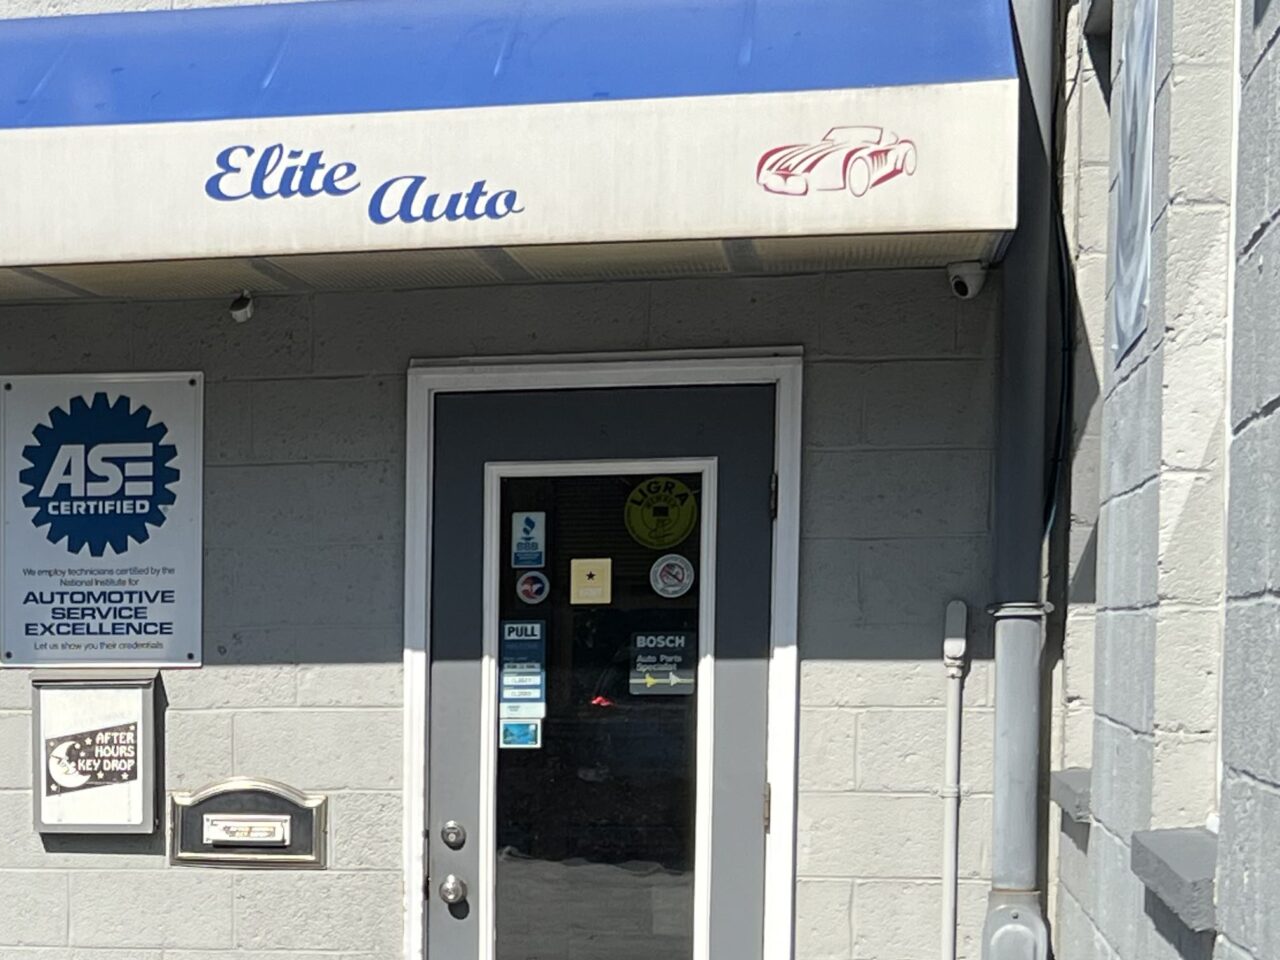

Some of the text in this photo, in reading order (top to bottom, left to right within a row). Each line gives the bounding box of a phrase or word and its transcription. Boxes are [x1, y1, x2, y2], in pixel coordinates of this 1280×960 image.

[205, 143, 525, 225] Elite Auto
[38, 442, 154, 498] ASE
[47, 500, 151, 515] CERTIFIED
[23, 566, 175, 578] We employ technicians certified by the
[60, 577, 139, 587] National Institute for
[23, 590, 175, 604] AUTOMOTIVE
[51, 606, 148, 619] SERVICE
[24, 622, 173, 636] EXCELLENCE
[507, 626, 538, 637] PULL
[34, 642, 48, 650] Let
[60, 642, 82, 650] show
[83, 643, 99, 651] you
[100, 641, 117, 650] their
[118, 641, 164, 650] credentials
[636, 635, 686, 648] BOSCH
[95, 732, 135, 744] AFTER
[94, 745, 135, 758] HOURS
[77, 758, 135, 771] KEY DROP
